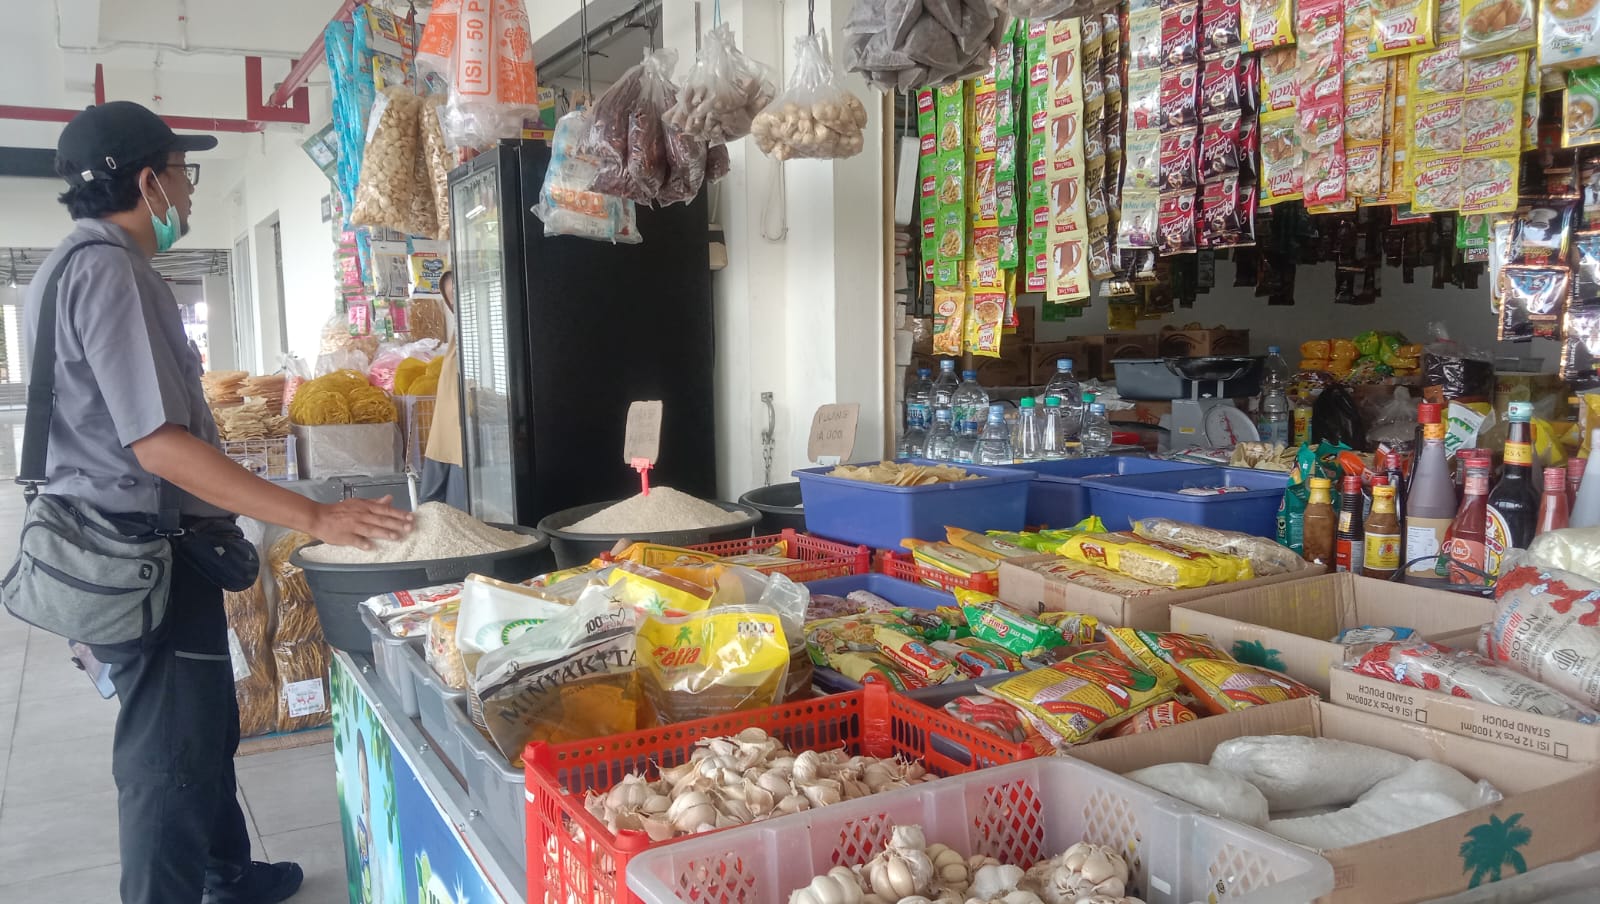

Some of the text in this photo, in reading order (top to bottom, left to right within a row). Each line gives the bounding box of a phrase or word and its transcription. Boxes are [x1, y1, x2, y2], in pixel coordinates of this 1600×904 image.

[466, 20, 484, 41] 50
[465, 60, 482, 84] ISI
[1511, 614, 1539, 660] SOHUN
[498, 648, 637, 726] MINYAKITA
[1358, 684, 1414, 705] STAND POUCH
[1346, 692, 1372, 707] 2000ml
[1381, 702, 1394, 712] Pcs
[1461, 721, 1550, 751] ISI 12 Pcs X 1000ml
[1483, 714, 1550, 738] STAND POUCH
